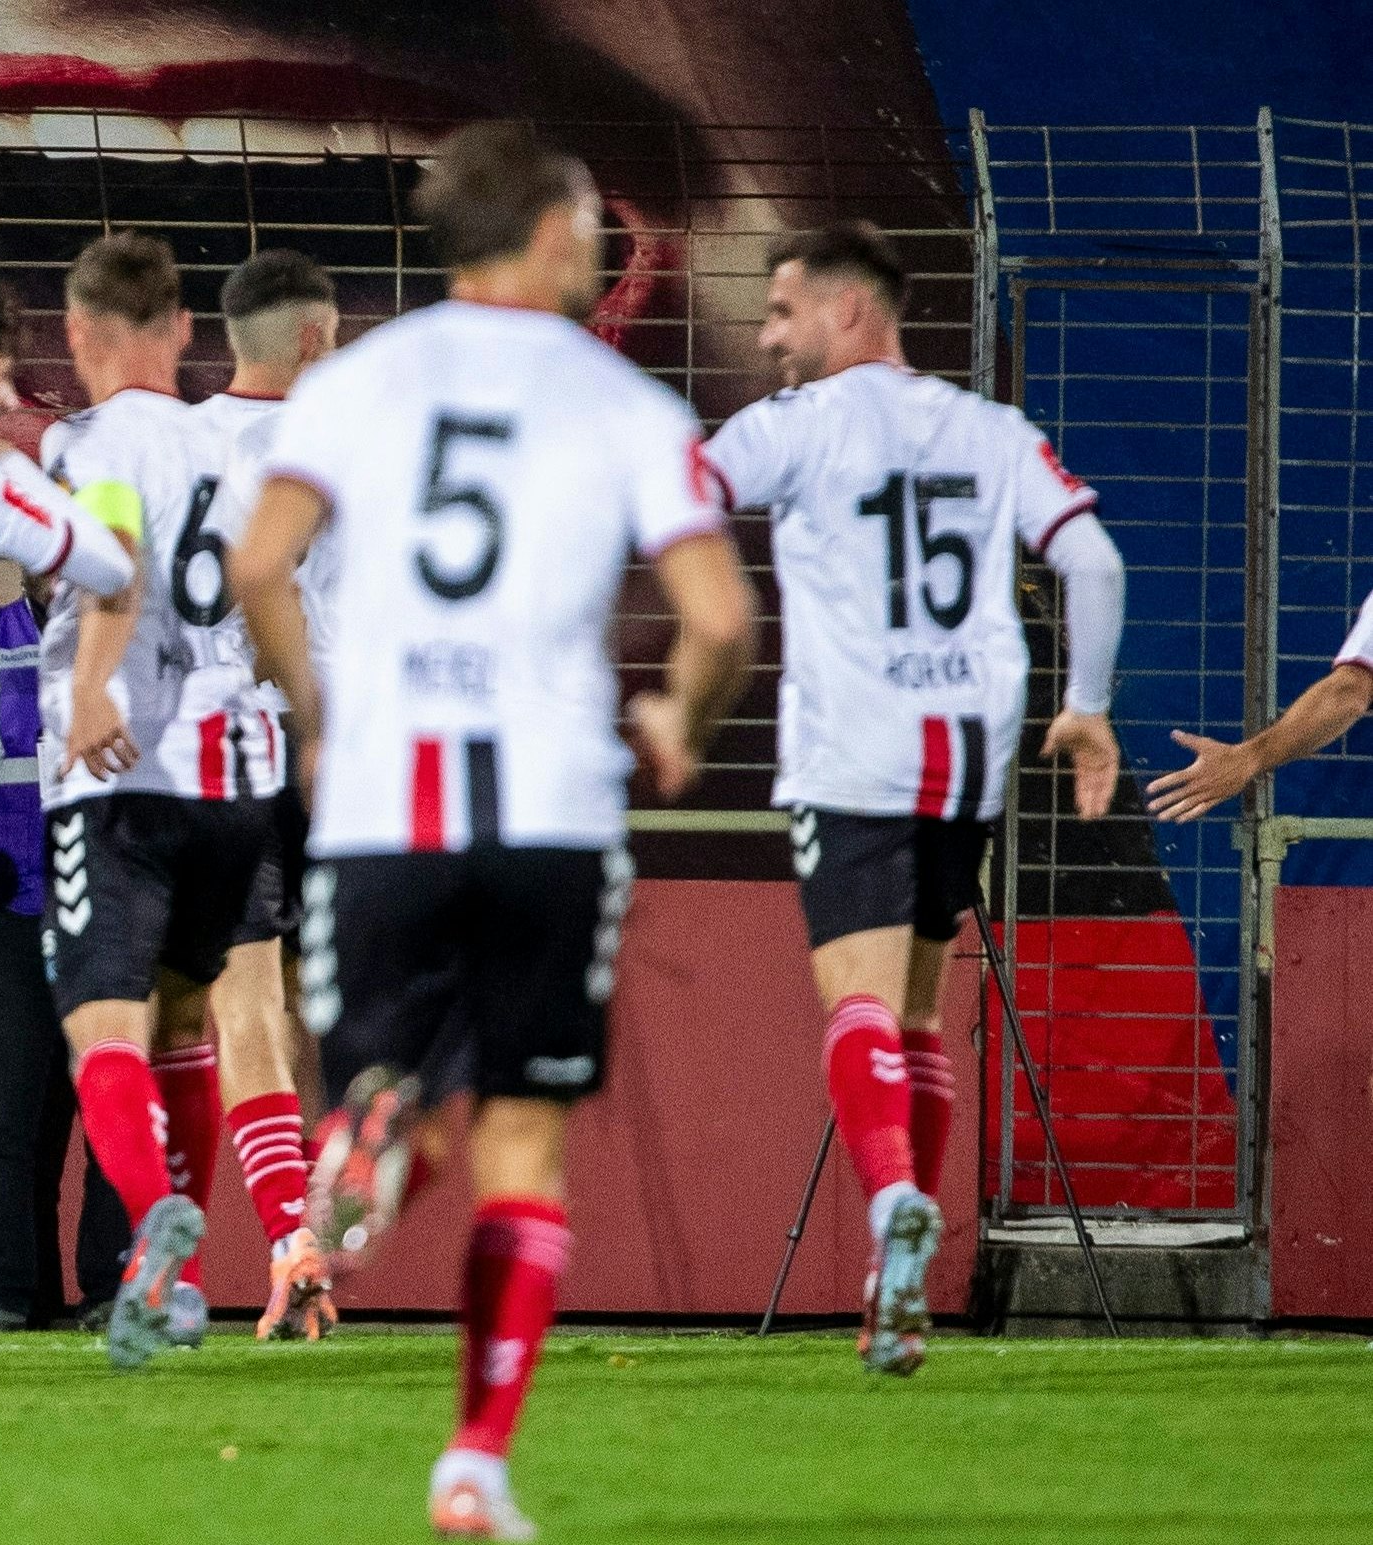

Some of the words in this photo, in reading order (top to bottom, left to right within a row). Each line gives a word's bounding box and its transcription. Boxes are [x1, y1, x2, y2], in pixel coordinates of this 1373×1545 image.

[170, 475, 233, 628] 6
[414, 409, 515, 603] 5
[857, 470, 978, 631] 15
